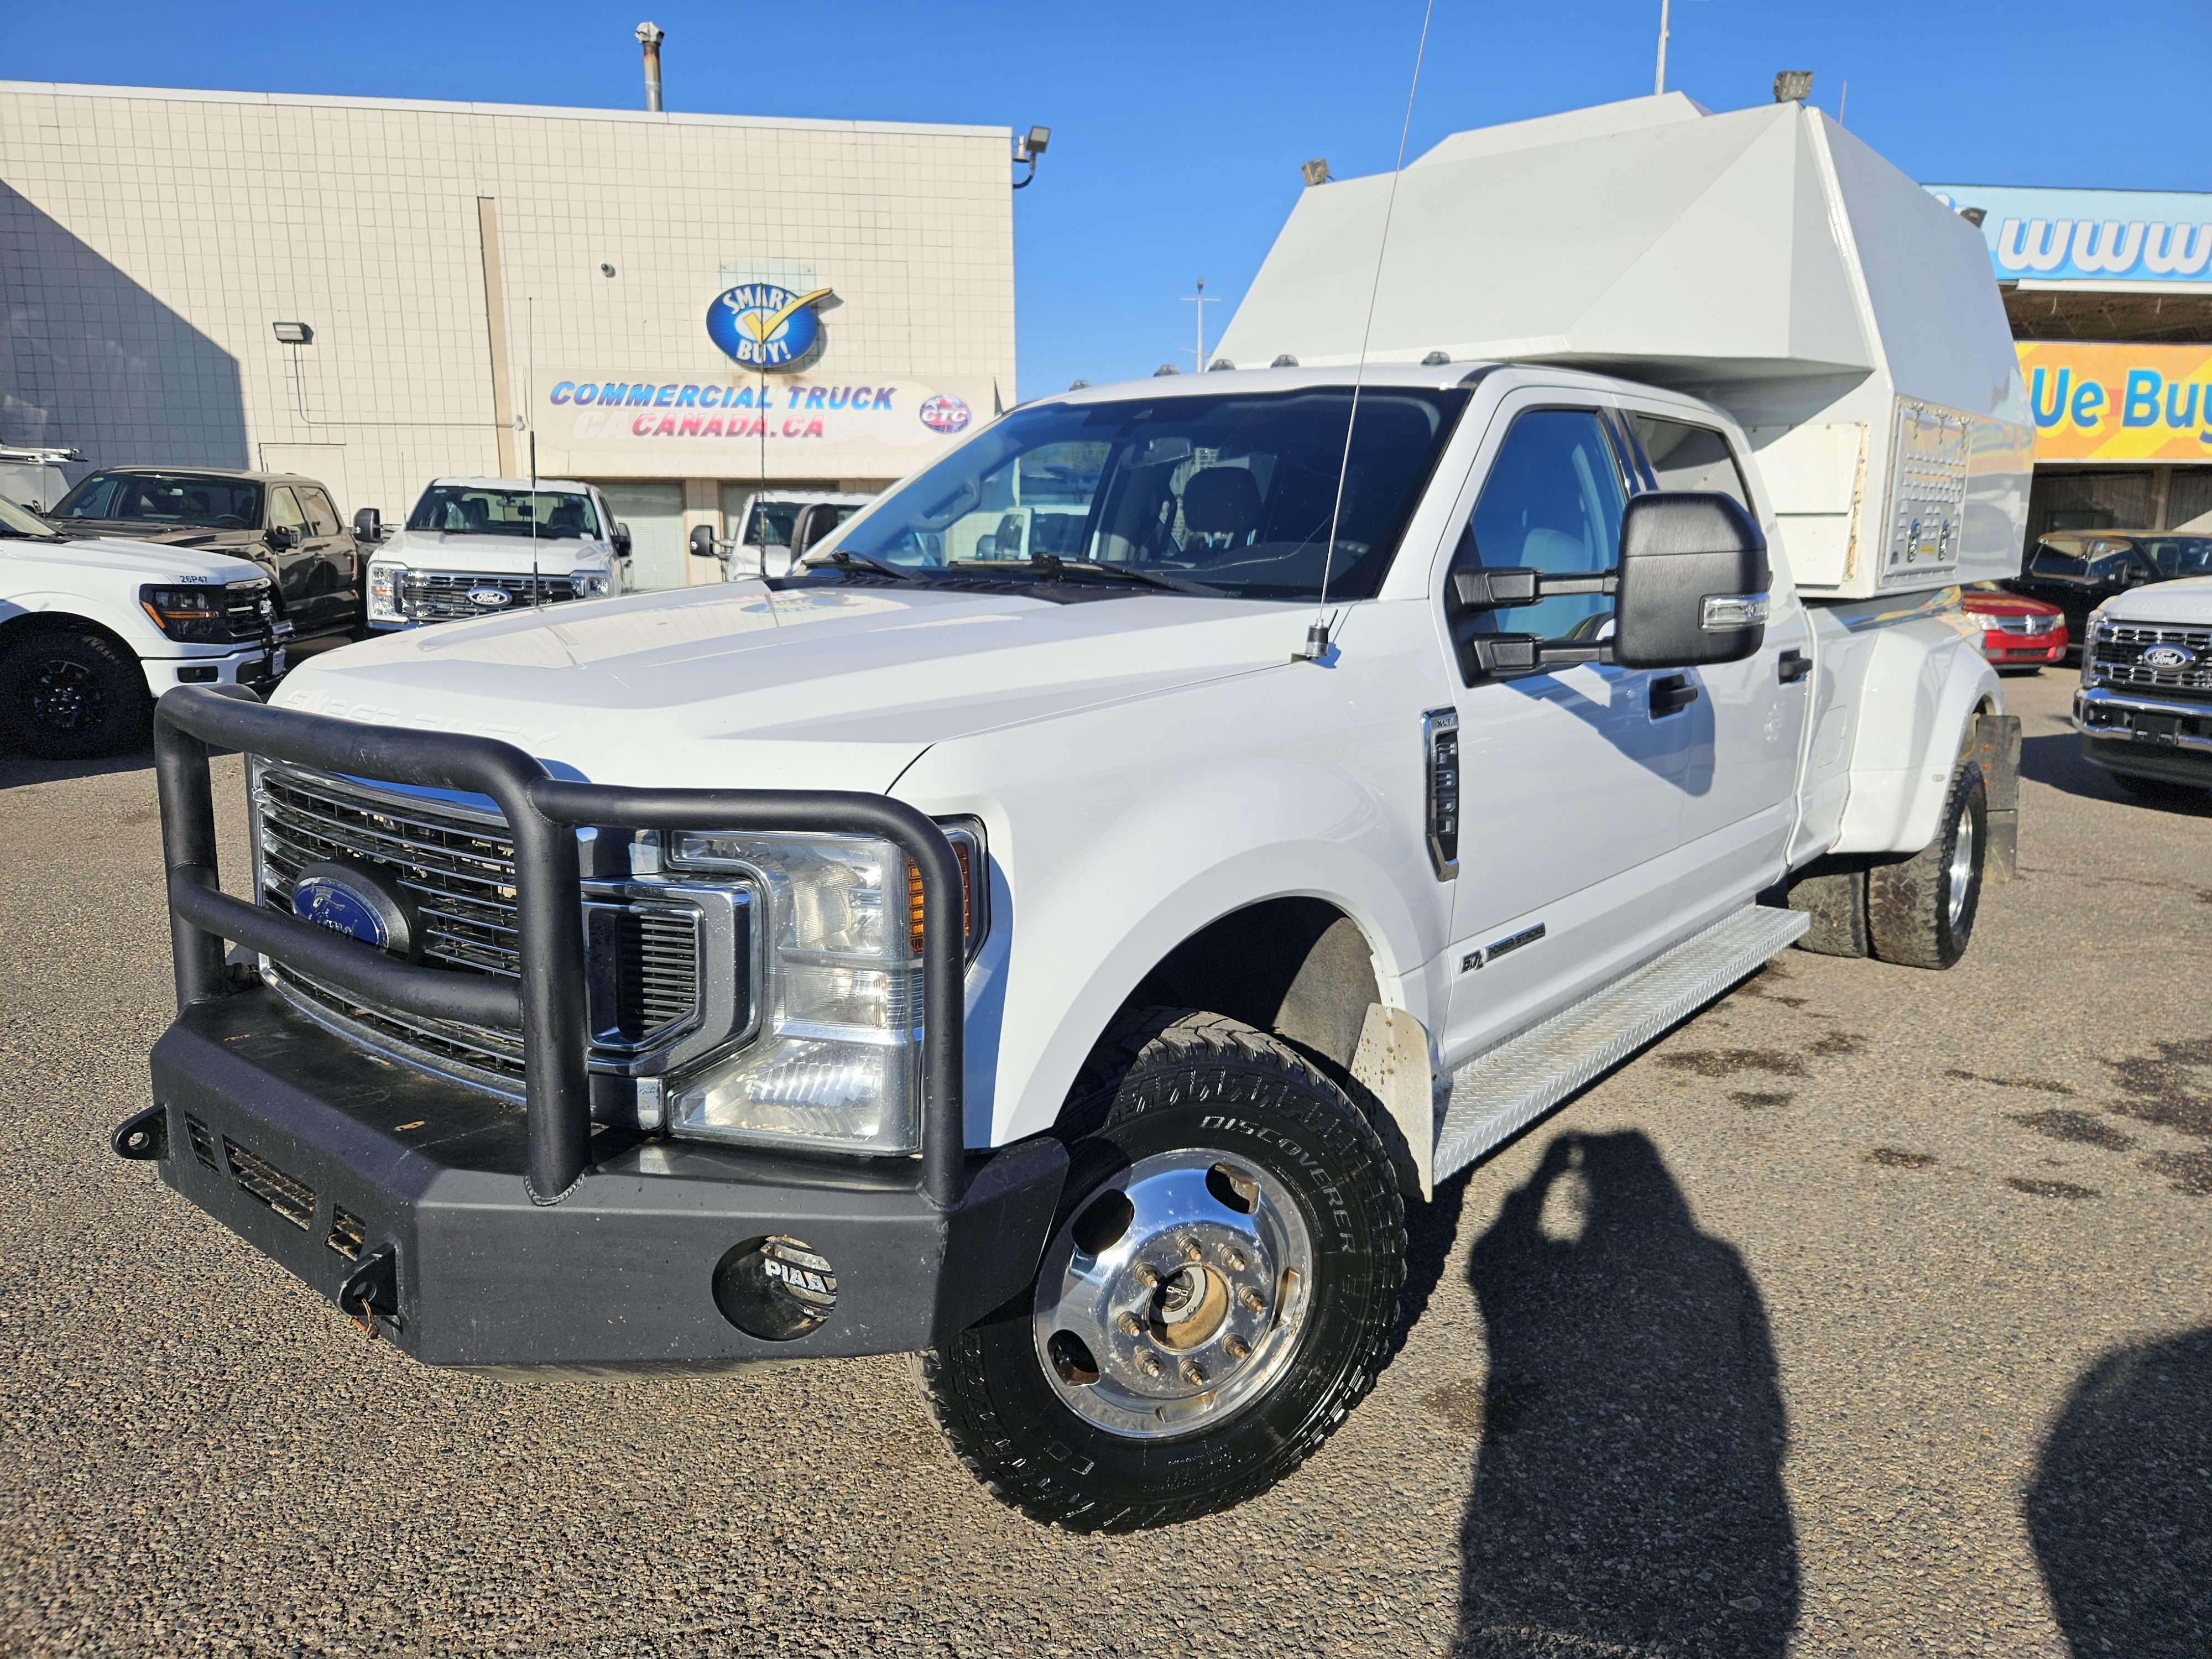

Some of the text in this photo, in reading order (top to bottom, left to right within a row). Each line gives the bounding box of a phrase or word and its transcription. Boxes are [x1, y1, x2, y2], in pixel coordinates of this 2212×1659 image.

[722, 285, 798, 315] SMART
[736, 338, 791, 363] BUY!
[550, 381, 898, 411] COMMERCIAL TRUCK
[632, 413, 825, 439] CANADA.CA
[921, 408, 968, 422] CTC
[179, 575, 208, 583] 26P47
[476, 592, 500, 603] Ford
[2152, 650, 2178, 665] Ford
[1437, 718, 1453, 728] XLT
[1488, 925, 1546, 957] POWER STROKE
[1199, 1115, 1355, 1254] DISCOVERER
[764, 1258, 828, 1294] PIAA
[1166, 1285, 1190, 1297] ORD
